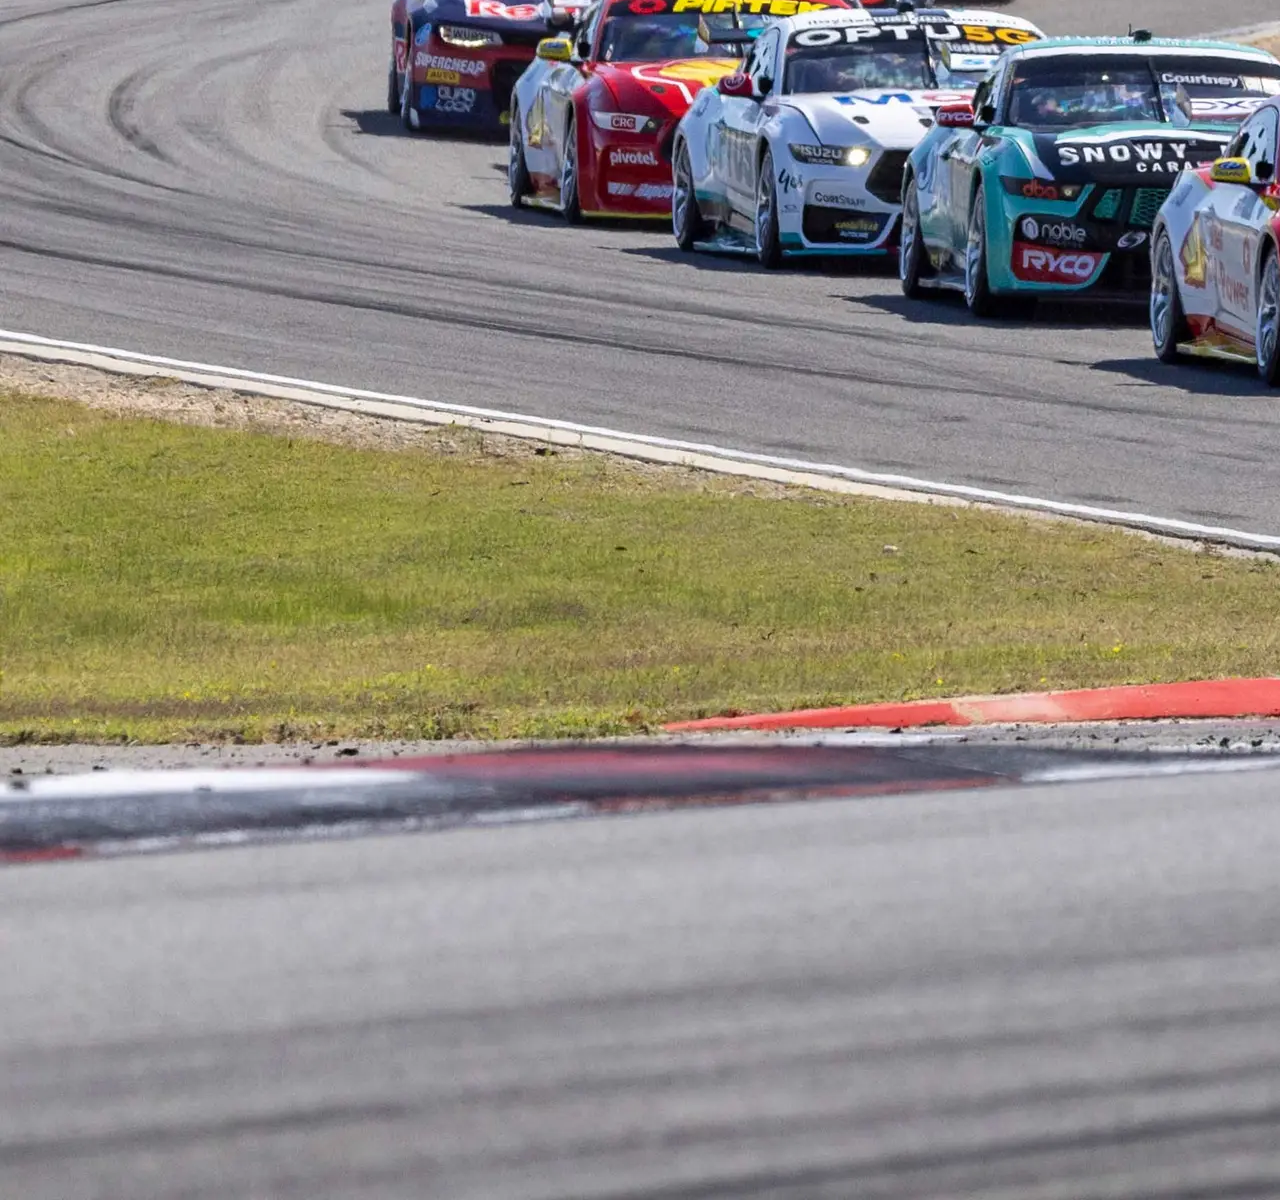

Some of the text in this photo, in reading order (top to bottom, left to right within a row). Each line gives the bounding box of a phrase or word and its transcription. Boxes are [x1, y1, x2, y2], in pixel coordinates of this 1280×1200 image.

[1162, 73, 1239, 88] Courtney
[1058, 143, 1187, 166] SNOWY
[1023, 178, 1058, 200] dba
[1023, 249, 1095, 277] RYCO
